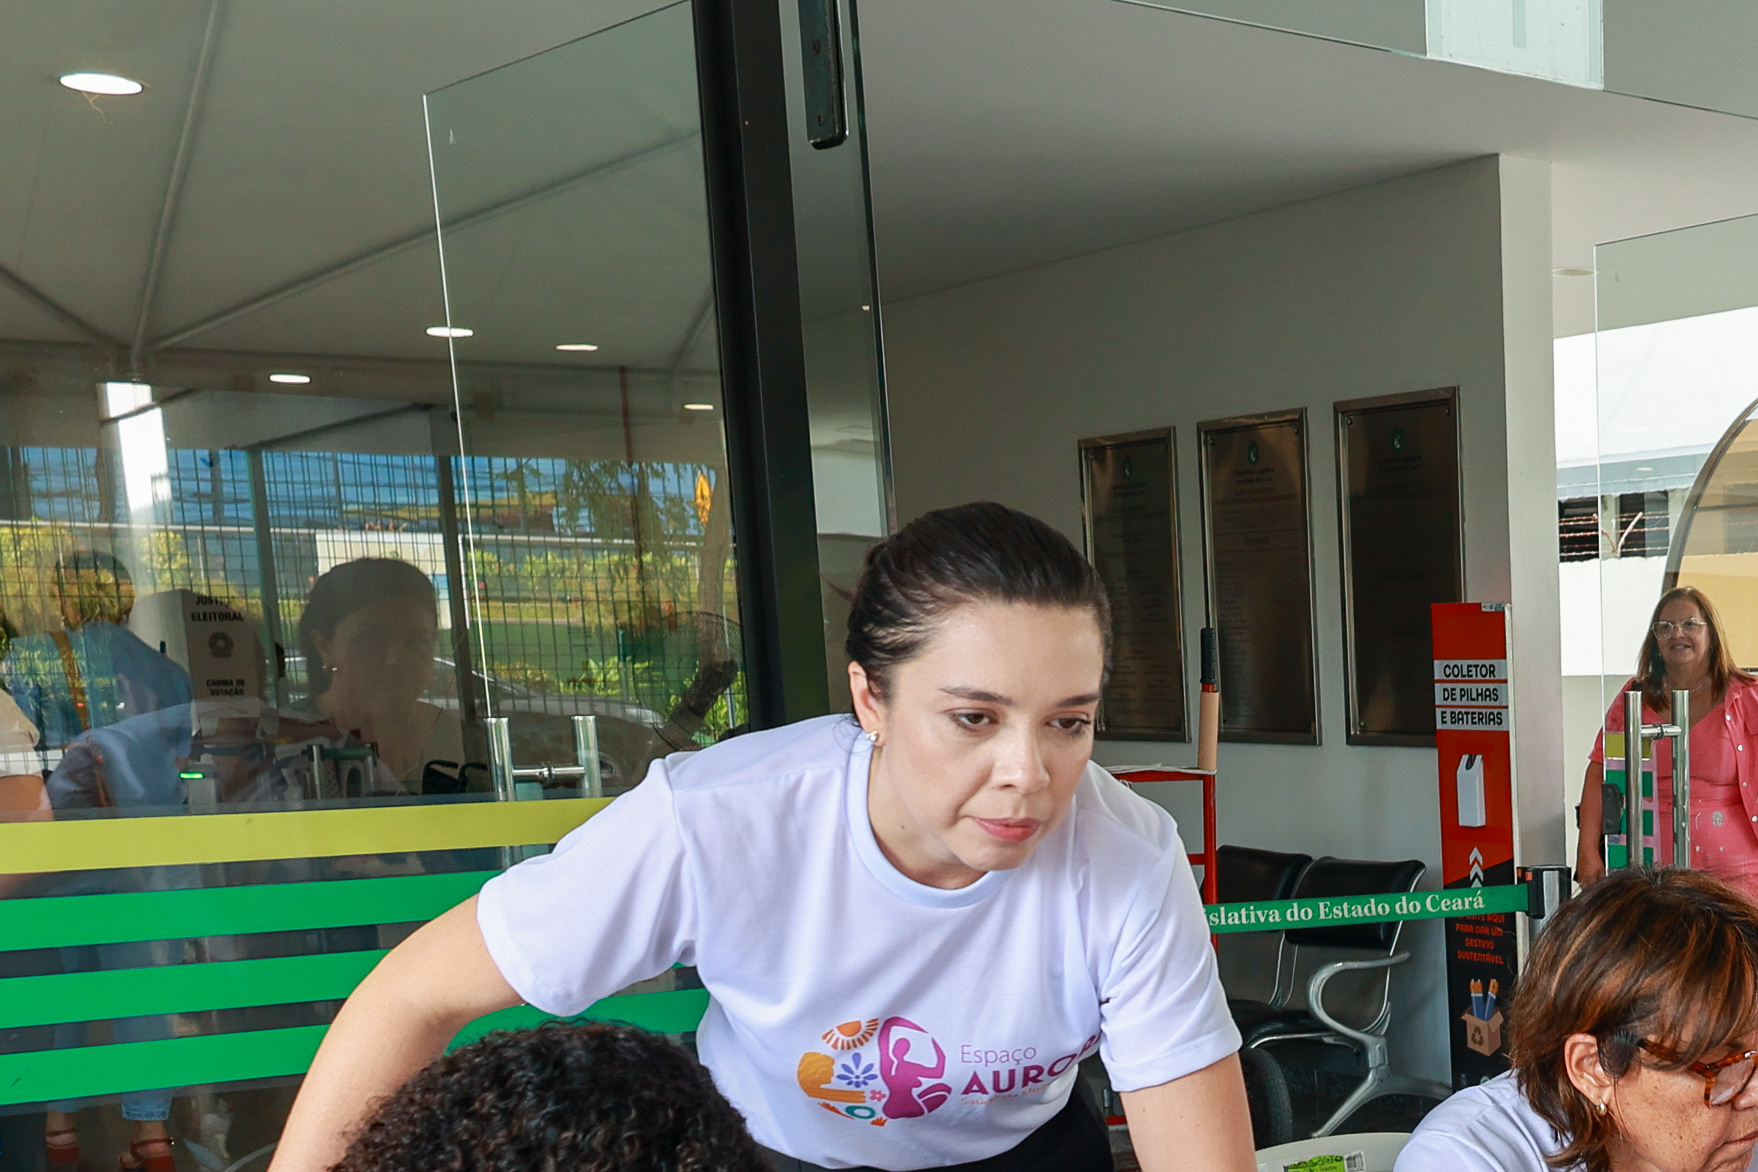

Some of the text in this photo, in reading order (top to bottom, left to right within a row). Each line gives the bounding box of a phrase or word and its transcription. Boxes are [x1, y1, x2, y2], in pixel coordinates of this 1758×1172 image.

[191, 611, 244, 621] ELEITORAL
[1443, 664, 1496, 678] COLETOR
[1442, 687, 1499, 701] DE PILHAS
[1440, 711, 1503, 725] E BATERIAS
[1285, 902, 1314, 921] do
[1319, 898, 1390, 919] Estado
[1395, 897, 1421, 915] do
[1426, 890, 1485, 912] Ceará
[1456, 923, 1474, 933] PARA
[1475, 926, 1489, 935] DAR
[1465, 938, 1494, 949] DESTINO
[1457, 950, 1504, 965] SUSTENTÁVEL
[961, 1044, 1037, 1067] Espaço
[961, 1032, 1101, 1095] AUROR
